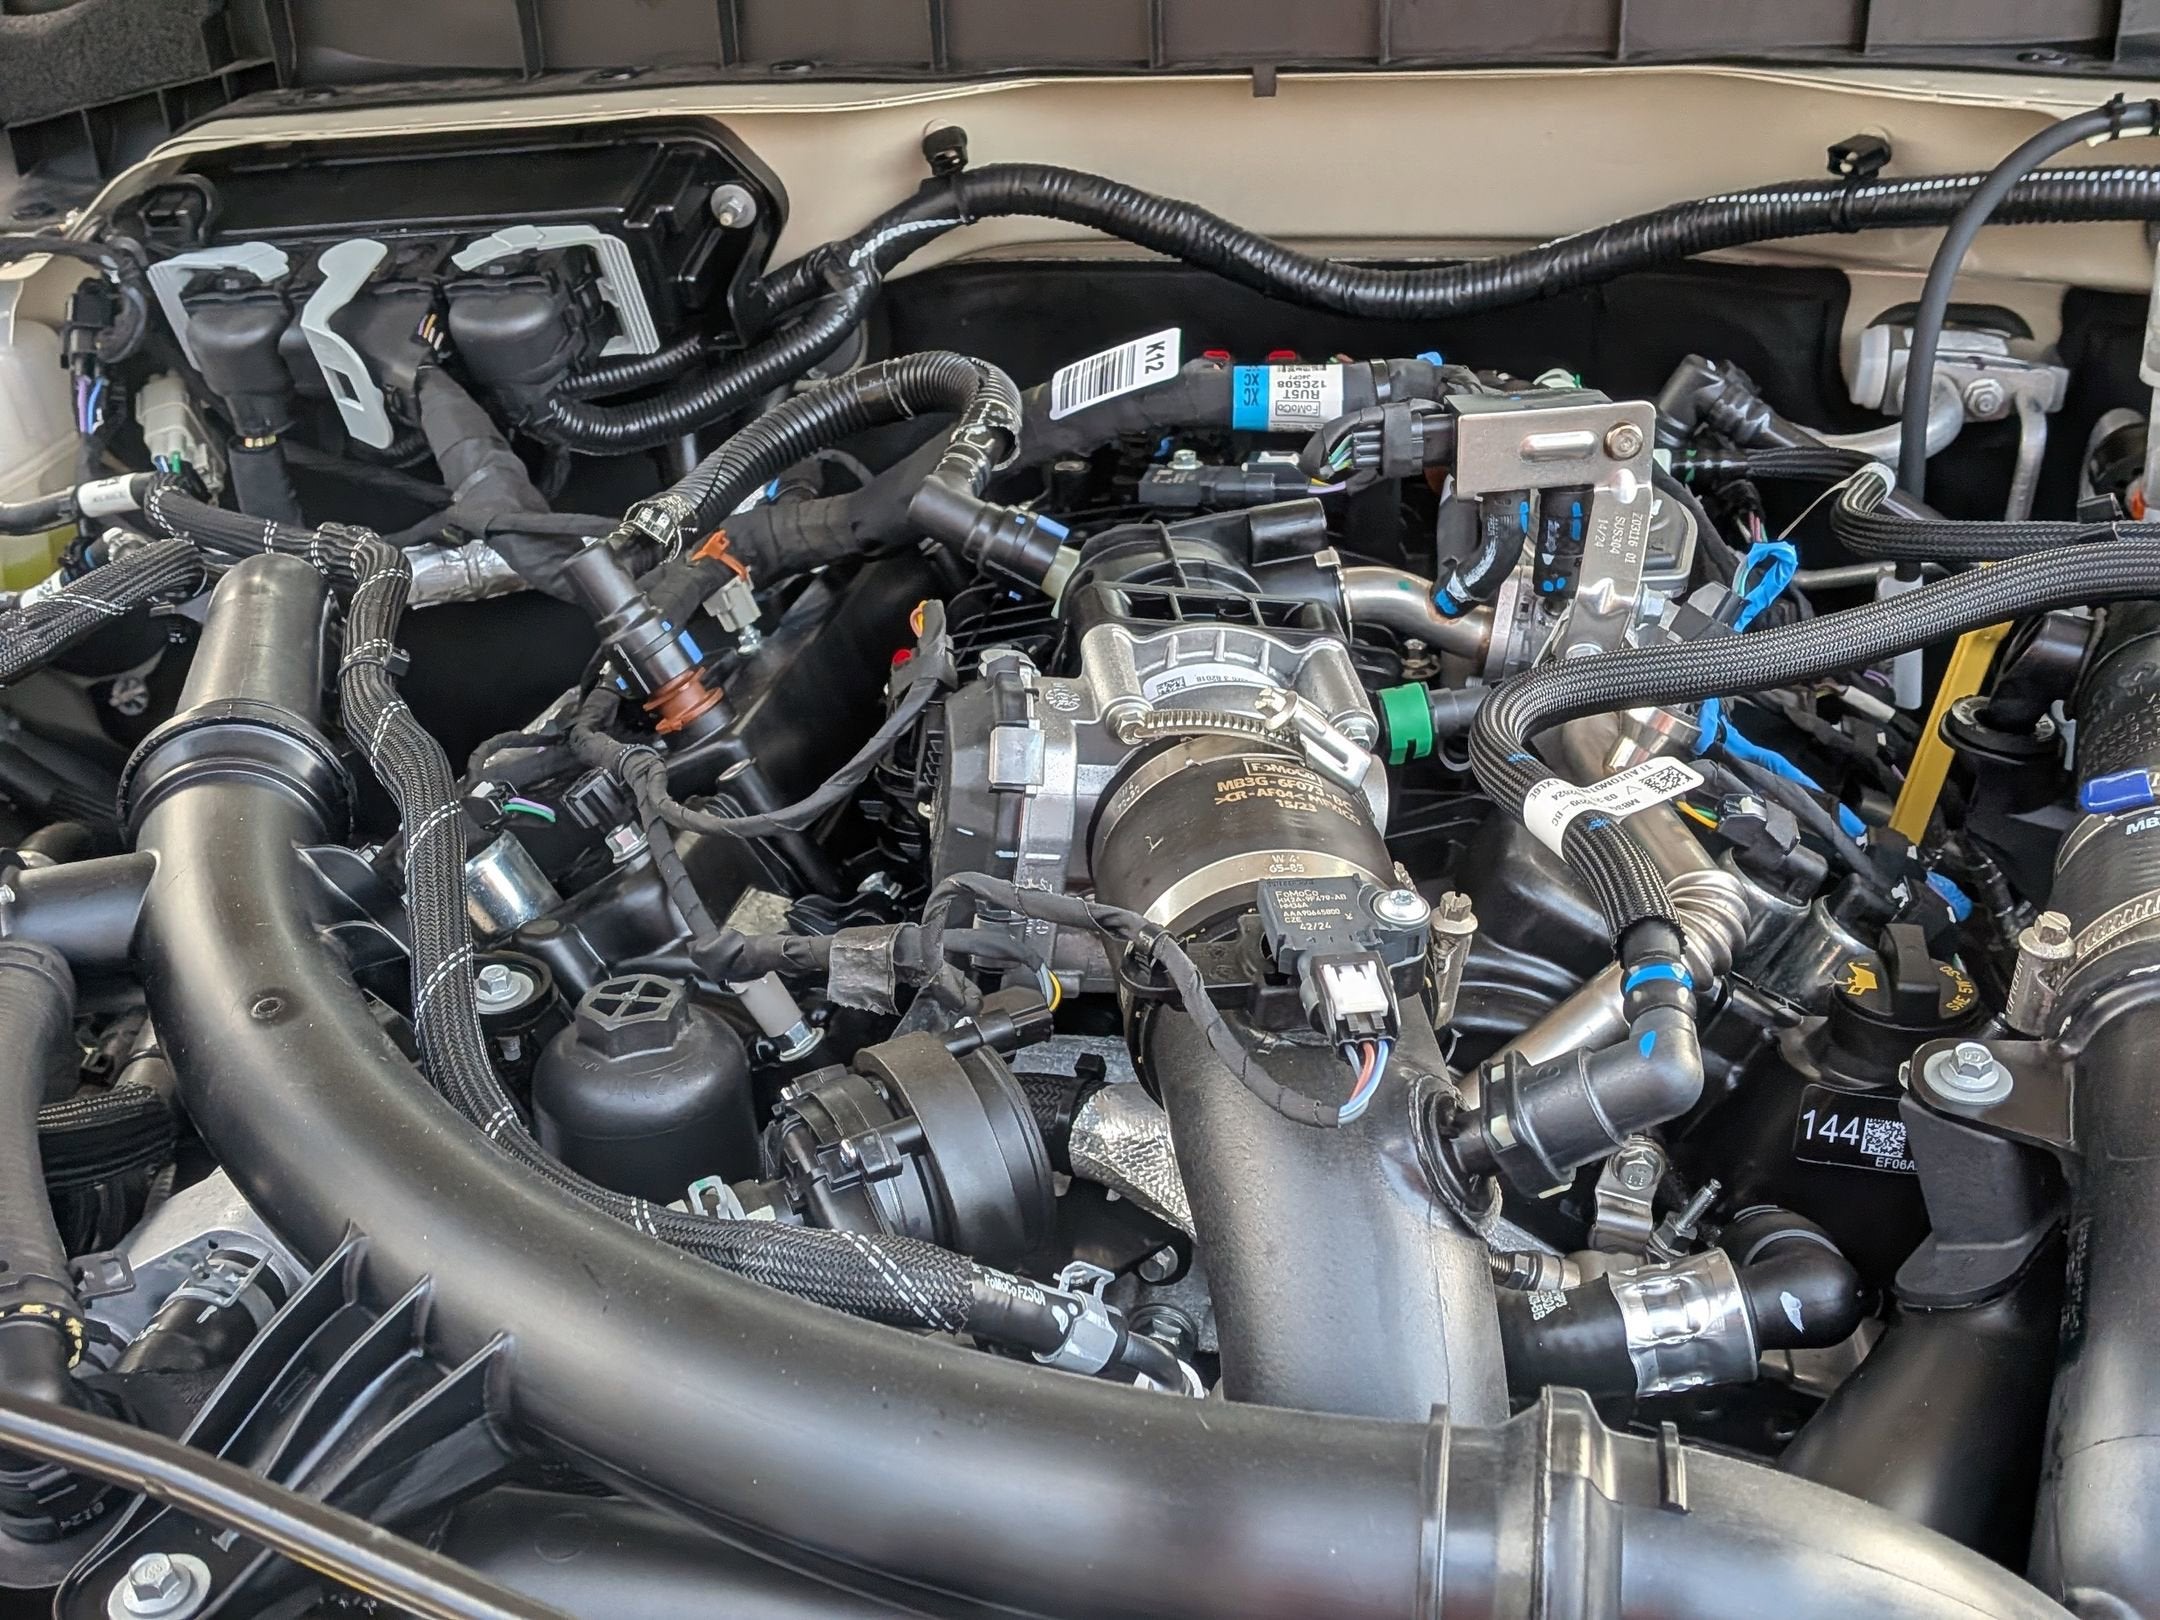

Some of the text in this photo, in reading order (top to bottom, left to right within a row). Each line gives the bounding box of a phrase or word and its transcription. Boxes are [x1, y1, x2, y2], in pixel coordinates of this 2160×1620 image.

[1143, 340, 1166, 375] K12
[1243, 373, 1260, 386] XC
[1276, 379, 1327, 389] 12C508
[1243, 387, 1260, 406] XC
[1276, 403, 1319, 415] FoMoCo
[1593, 518, 1608, 549] 14/24
[1609, 515, 1627, 555] SUS304
[1275, 889, 1319, 898] FoMoCo
[1300, 922, 1332, 931] 42/24
[1939, 965, 1974, 1011] SAE 5W-30
[1802, 1109, 1860, 1146] 144
[1875, 1156, 1917, 1171] EF06A
[984, 1273, 1017, 1297] FoMoCo
